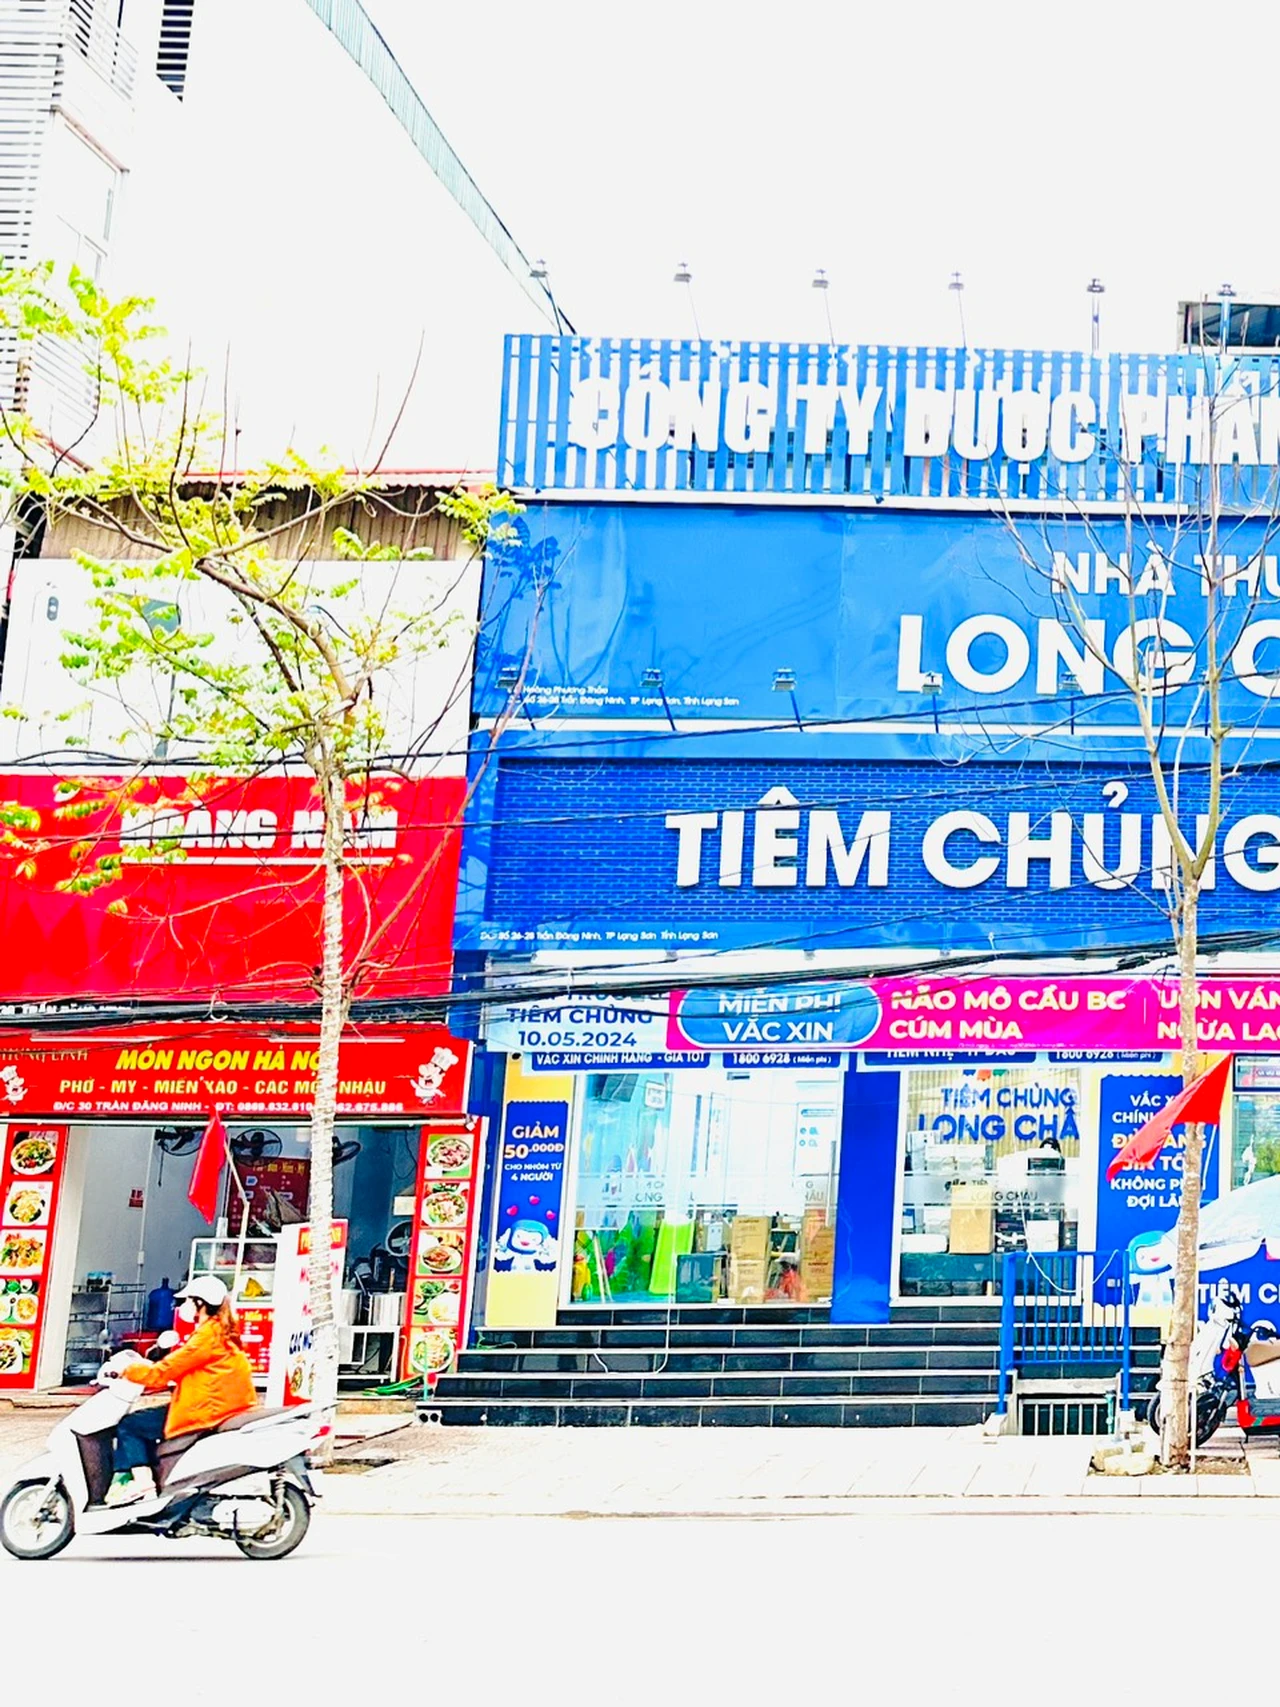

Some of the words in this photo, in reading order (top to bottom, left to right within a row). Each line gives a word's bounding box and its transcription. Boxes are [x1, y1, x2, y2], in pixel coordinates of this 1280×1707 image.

[798, 384, 885, 456] TY
[1052, 542, 1176, 597] NHÀ
[897, 613, 1197, 698] LONG
[665, 786, 893, 890] TIÊM
[891, 985, 956, 1010] NÃO
[963, 983, 1012, 1010] MÔ
[1087, 989, 1128, 1011] BC
[506, 1004, 562, 1024] TIÊM
[722, 1015, 782, 1041] VẮC
[786, 1021, 834, 1041] XIN
[889, 1017, 952, 1040] CÚM
[959, 1017, 1023, 1040] MÙA
[518, 1030, 638, 1048] 10.05.2024
[115, 1043, 174, 1071] MÓN
[177, 1049, 250, 1071] NGON
[562, 1052, 585, 1065] XIN
[733, 1053, 760, 1065] 1800
[763, 1053, 790, 1065] 6928
[78, 1102, 92, 1111] 30
[171, 1101, 202, 1111] NINH
[1130, 1090, 1161, 1107] VẮC
[511, 1121, 559, 1139] GIẢM
[1014, 1107, 1080, 1141] CHÂ
[1159, 1152, 1185, 1171] TỐ
[1110, 1175, 1166, 1190] KHÔNG
[1159, 1192, 1183, 1208] LÂ
[1198, 1277, 1251, 1304] TIÊM
